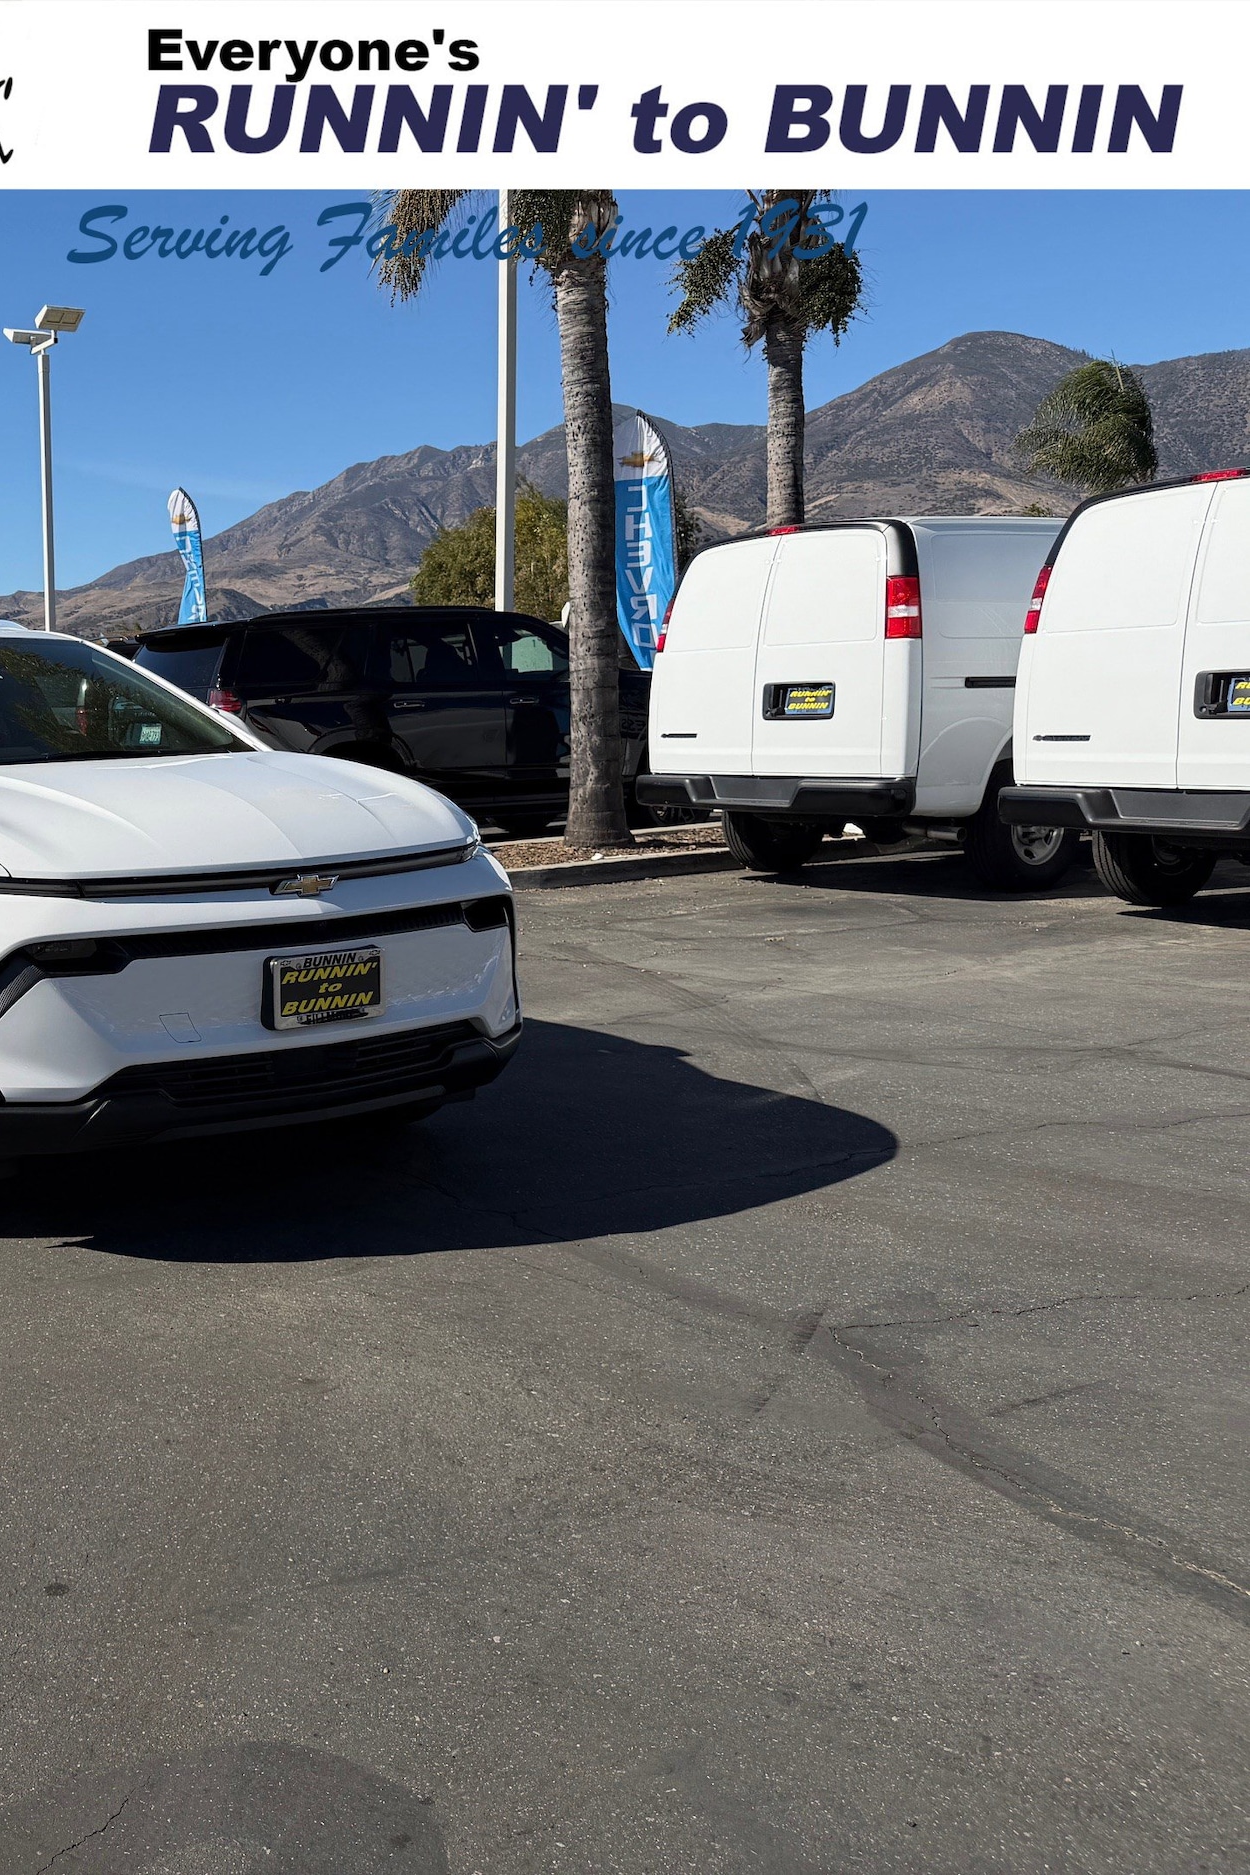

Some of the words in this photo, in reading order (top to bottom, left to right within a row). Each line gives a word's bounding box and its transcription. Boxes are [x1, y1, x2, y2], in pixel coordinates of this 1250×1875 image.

[303, 953, 357, 968] BUNNIN
[281, 962, 378, 985] RUNNIN'
[318, 982, 343, 994] to
[281, 991, 374, 1016] BUNNIN
